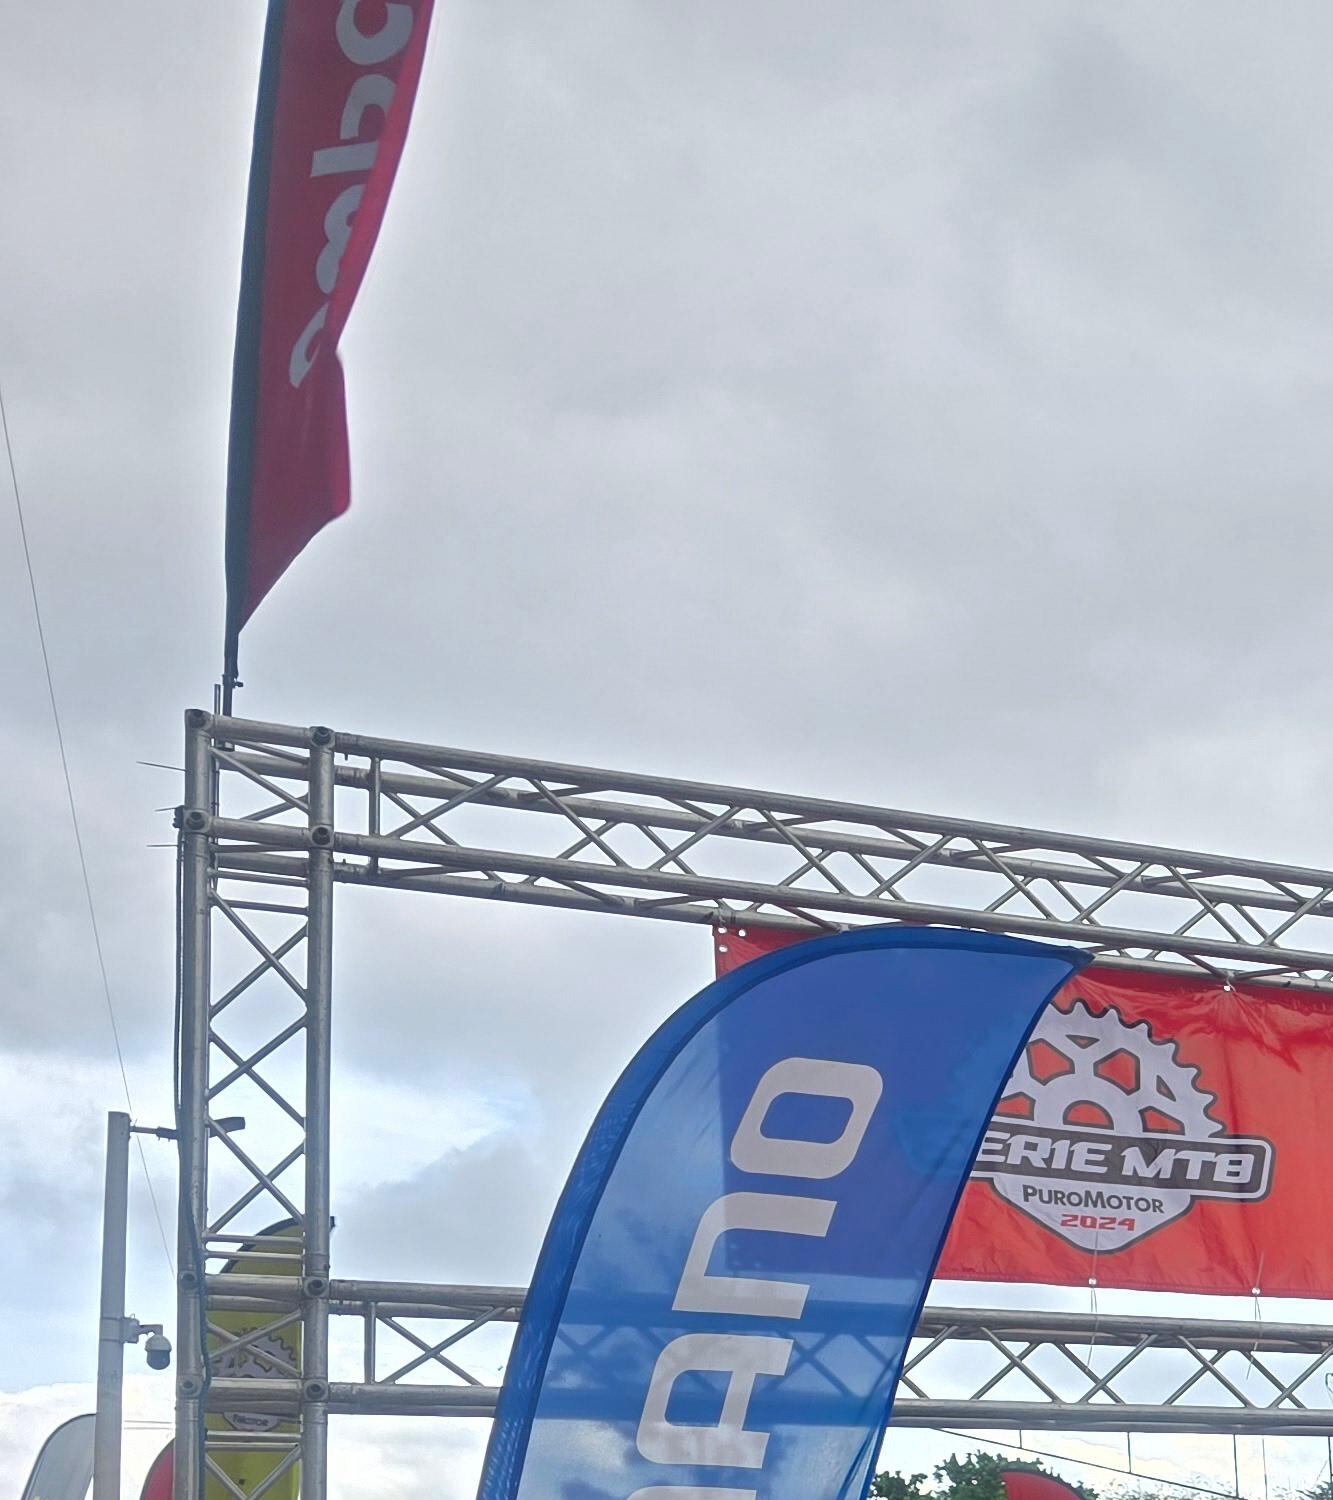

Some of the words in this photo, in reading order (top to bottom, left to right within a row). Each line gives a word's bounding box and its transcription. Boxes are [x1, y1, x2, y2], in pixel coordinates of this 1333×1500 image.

[975, 1130, 1110, 1177] ERIE
[1121, 1144, 1255, 1184] MTB
[1060, 1212, 1136, 1233] 2024
